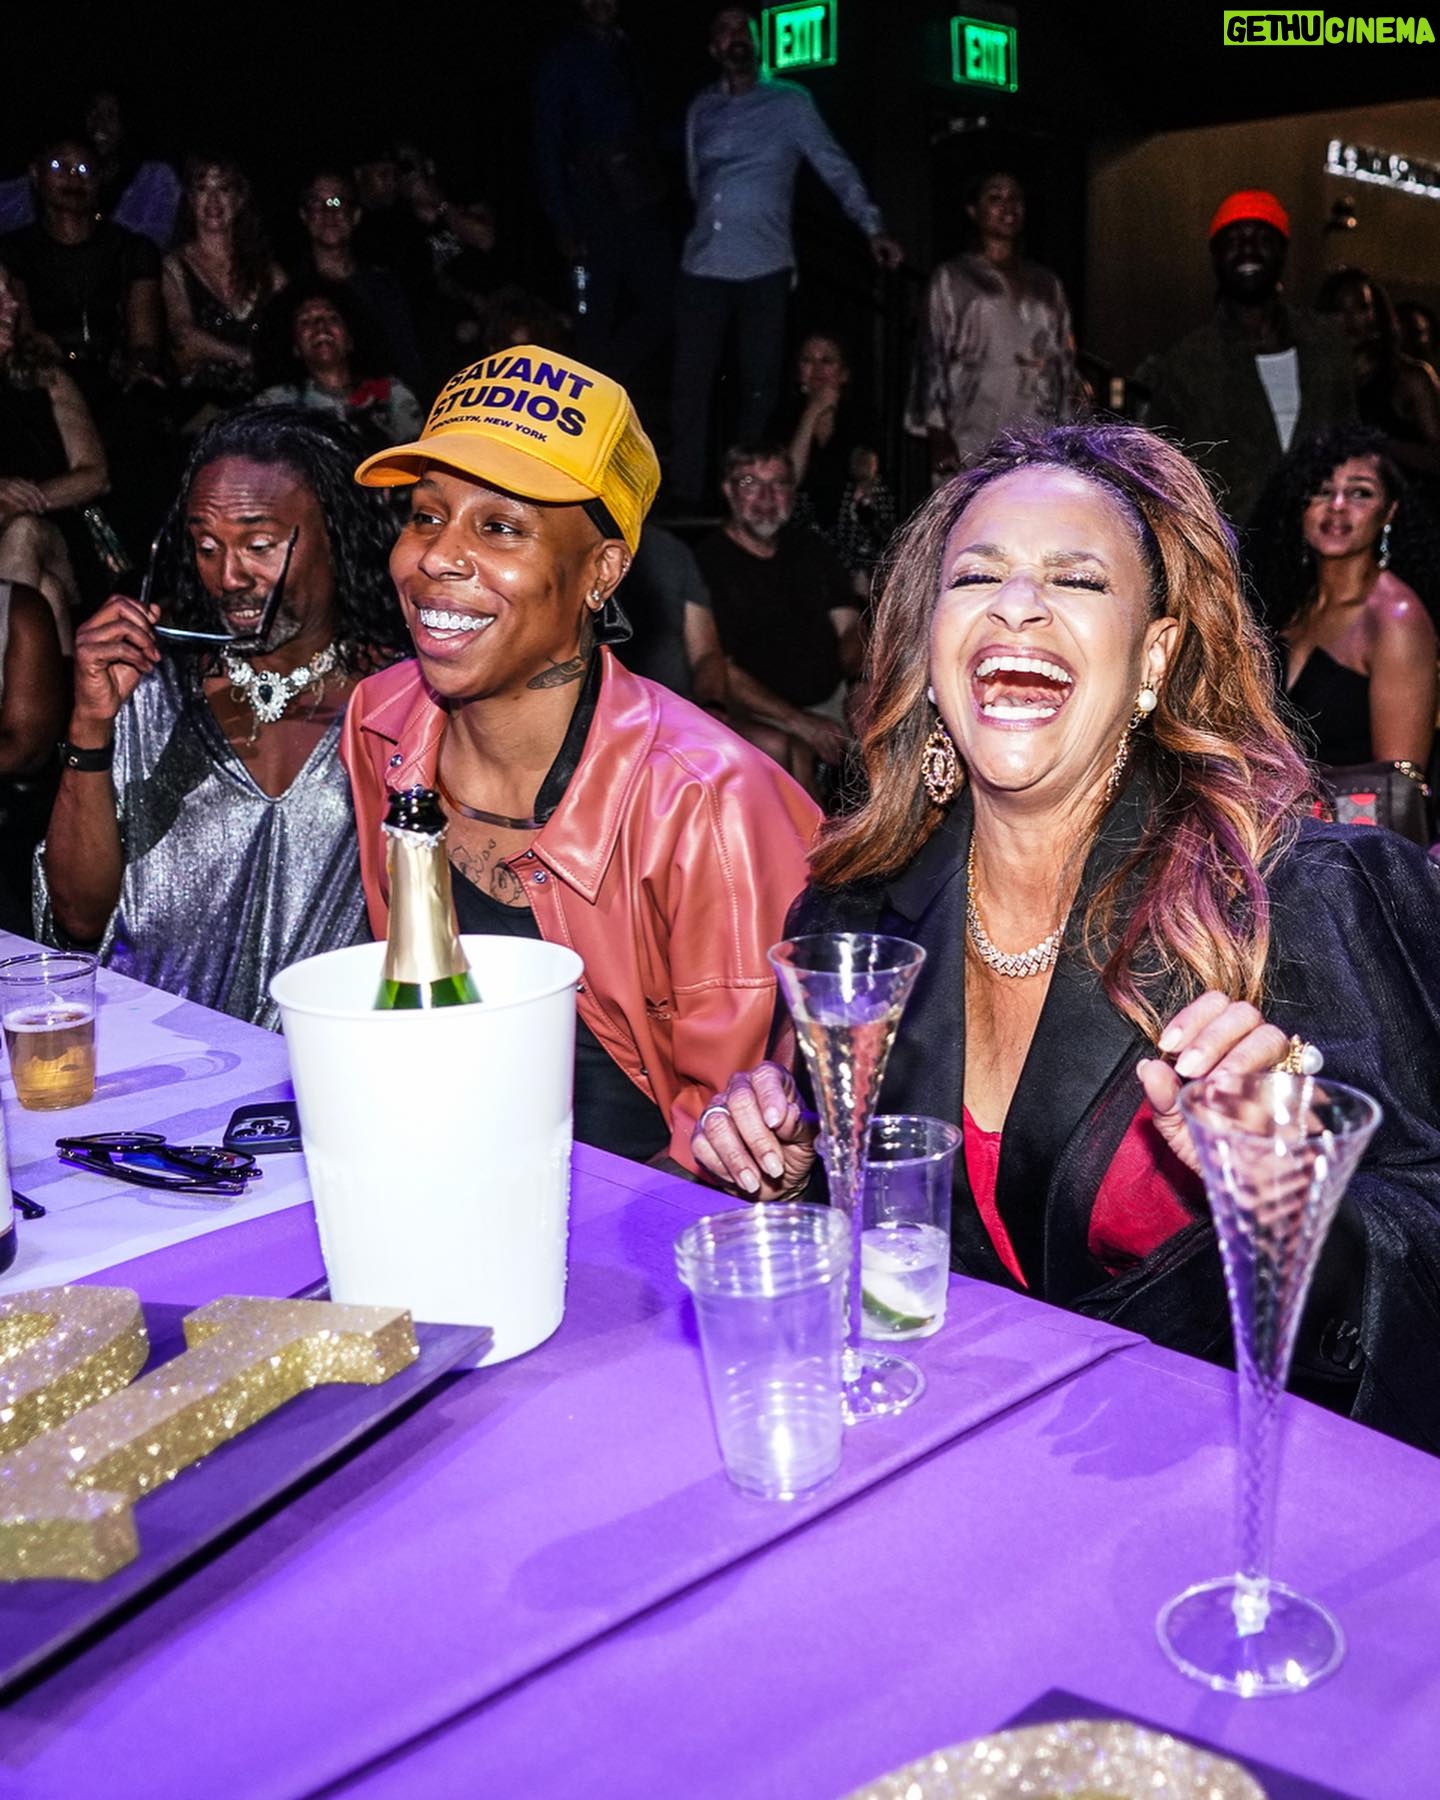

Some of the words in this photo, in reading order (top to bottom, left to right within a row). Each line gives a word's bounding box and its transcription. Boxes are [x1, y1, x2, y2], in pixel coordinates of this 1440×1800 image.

[446, 356, 594, 400] SAVANT
[429, 385, 587, 437] STUDIOS
[483, 417, 513, 428] NEW
[515, 423, 548, 443] YORK
